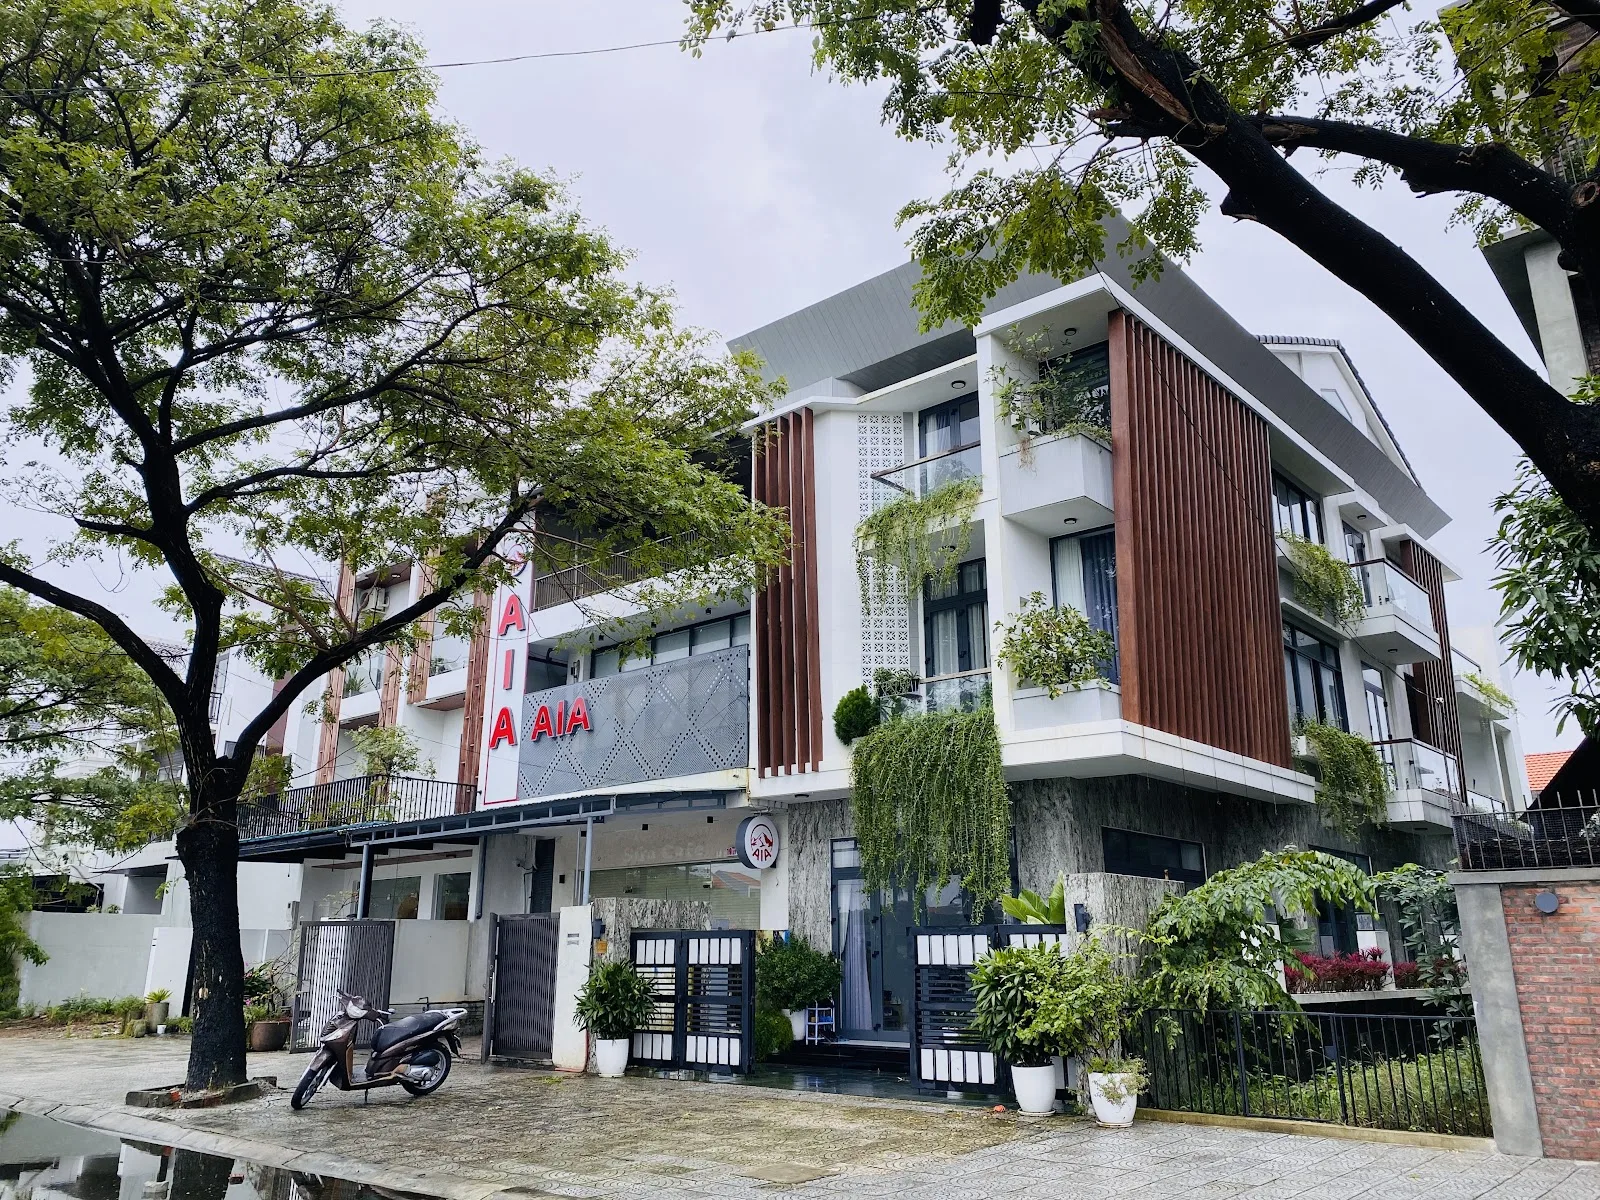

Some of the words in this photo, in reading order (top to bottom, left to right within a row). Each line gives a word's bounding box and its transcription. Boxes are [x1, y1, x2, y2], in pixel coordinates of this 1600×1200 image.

[489, 594, 526, 749] AIA
[530, 696, 592, 742] AIA
[752, 848, 772, 862] AIA
